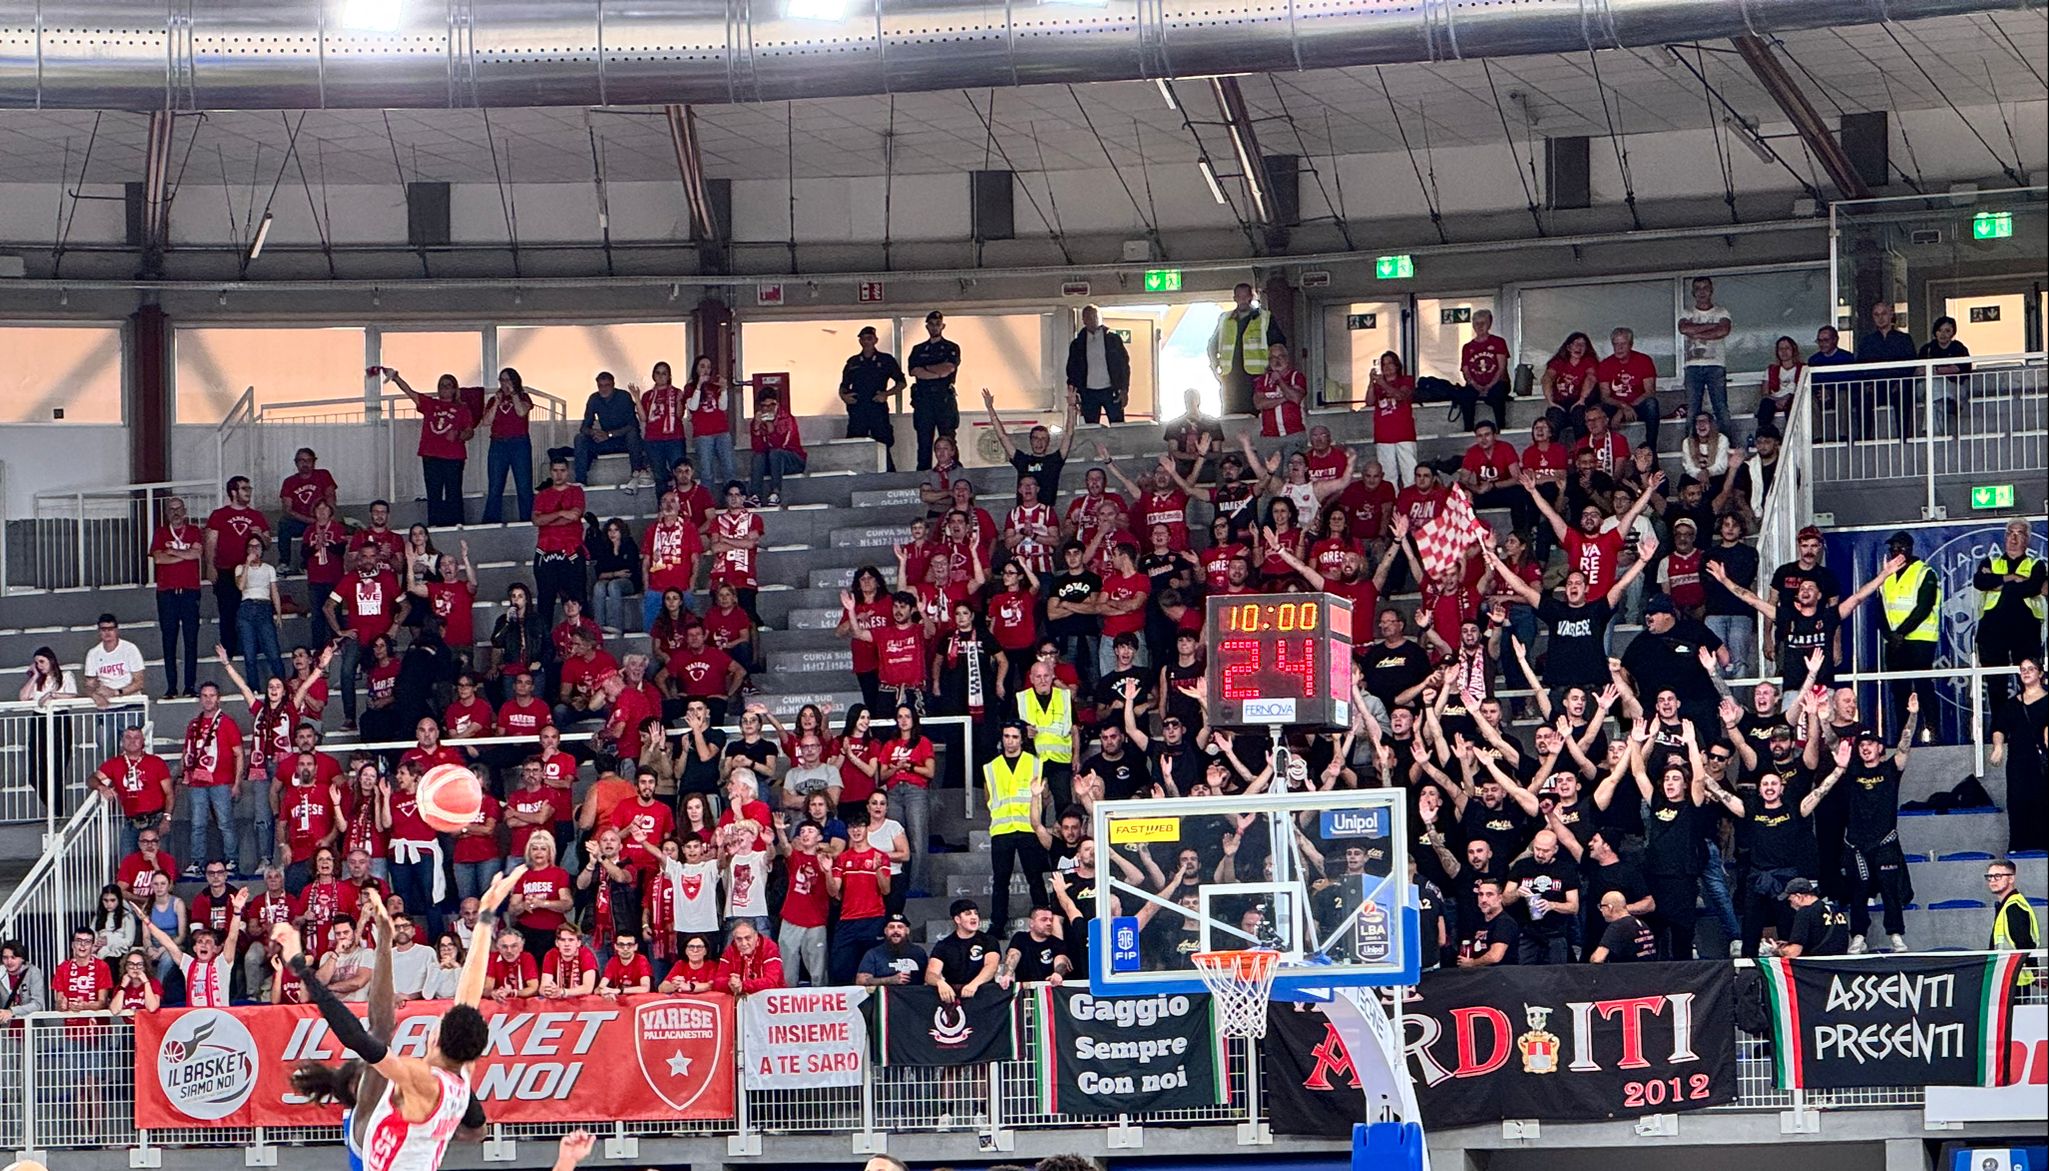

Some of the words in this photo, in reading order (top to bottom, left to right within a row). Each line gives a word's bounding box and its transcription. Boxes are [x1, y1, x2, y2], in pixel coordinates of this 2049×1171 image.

[1410, 501, 1437, 519] RUN
[1582, 543, 1601, 557] VA
[1580, 557, 1600, 571] RE
[1230, 602, 1317, 631] 10:00
[1788, 633, 1825, 644] VARESE
[803, 653, 832, 661] CURVA
[1223, 638, 1315, 699] 24
[782, 697, 813, 705] CURVA
[815, 695, 833, 703] SUD
[1245, 704, 1294, 715] FERNOVA
[1334, 812, 1378, 832] Unipol
[523, 882, 553, 894] VARESE
[1361, 925, 1386, 935] LBA
[1823, 913, 1848, 926] 212
[1116, 952, 1137, 961] FIP
[1363, 946, 1385, 955] Unipol
[1825, 971, 1955, 1014] ASSENTI
[767, 993, 848, 1015] SEMPRE
[1069, 994, 1190, 1027] Gaggio
[641, 1007, 713, 1029] VARESE
[281, 1018, 334, 1060] IL
[643, 1029, 714, 1040] PALLACANESTRO
[768, 1023, 849, 1044] INSIEME
[1815, 1017, 1965, 1064] PRESENTI
[1075, 1036, 1188, 1063] Sempre
[168, 1069, 181, 1088] IL
[184, 1051, 247, 1084] BASKET
[760, 1056, 772, 1074] A
[778, 1055, 800, 1074] TE
[808, 1048, 859, 1072] SARÒ
[180, 1080, 214, 1099] SIAMO
[217, 1074, 235, 1091] NOI
[475, 1062, 583, 1100] NOI
[1078, 1071, 1134, 1095] Con
[1142, 1066, 1188, 1091] noi
[1624, 1074, 1710, 1107] 2012
